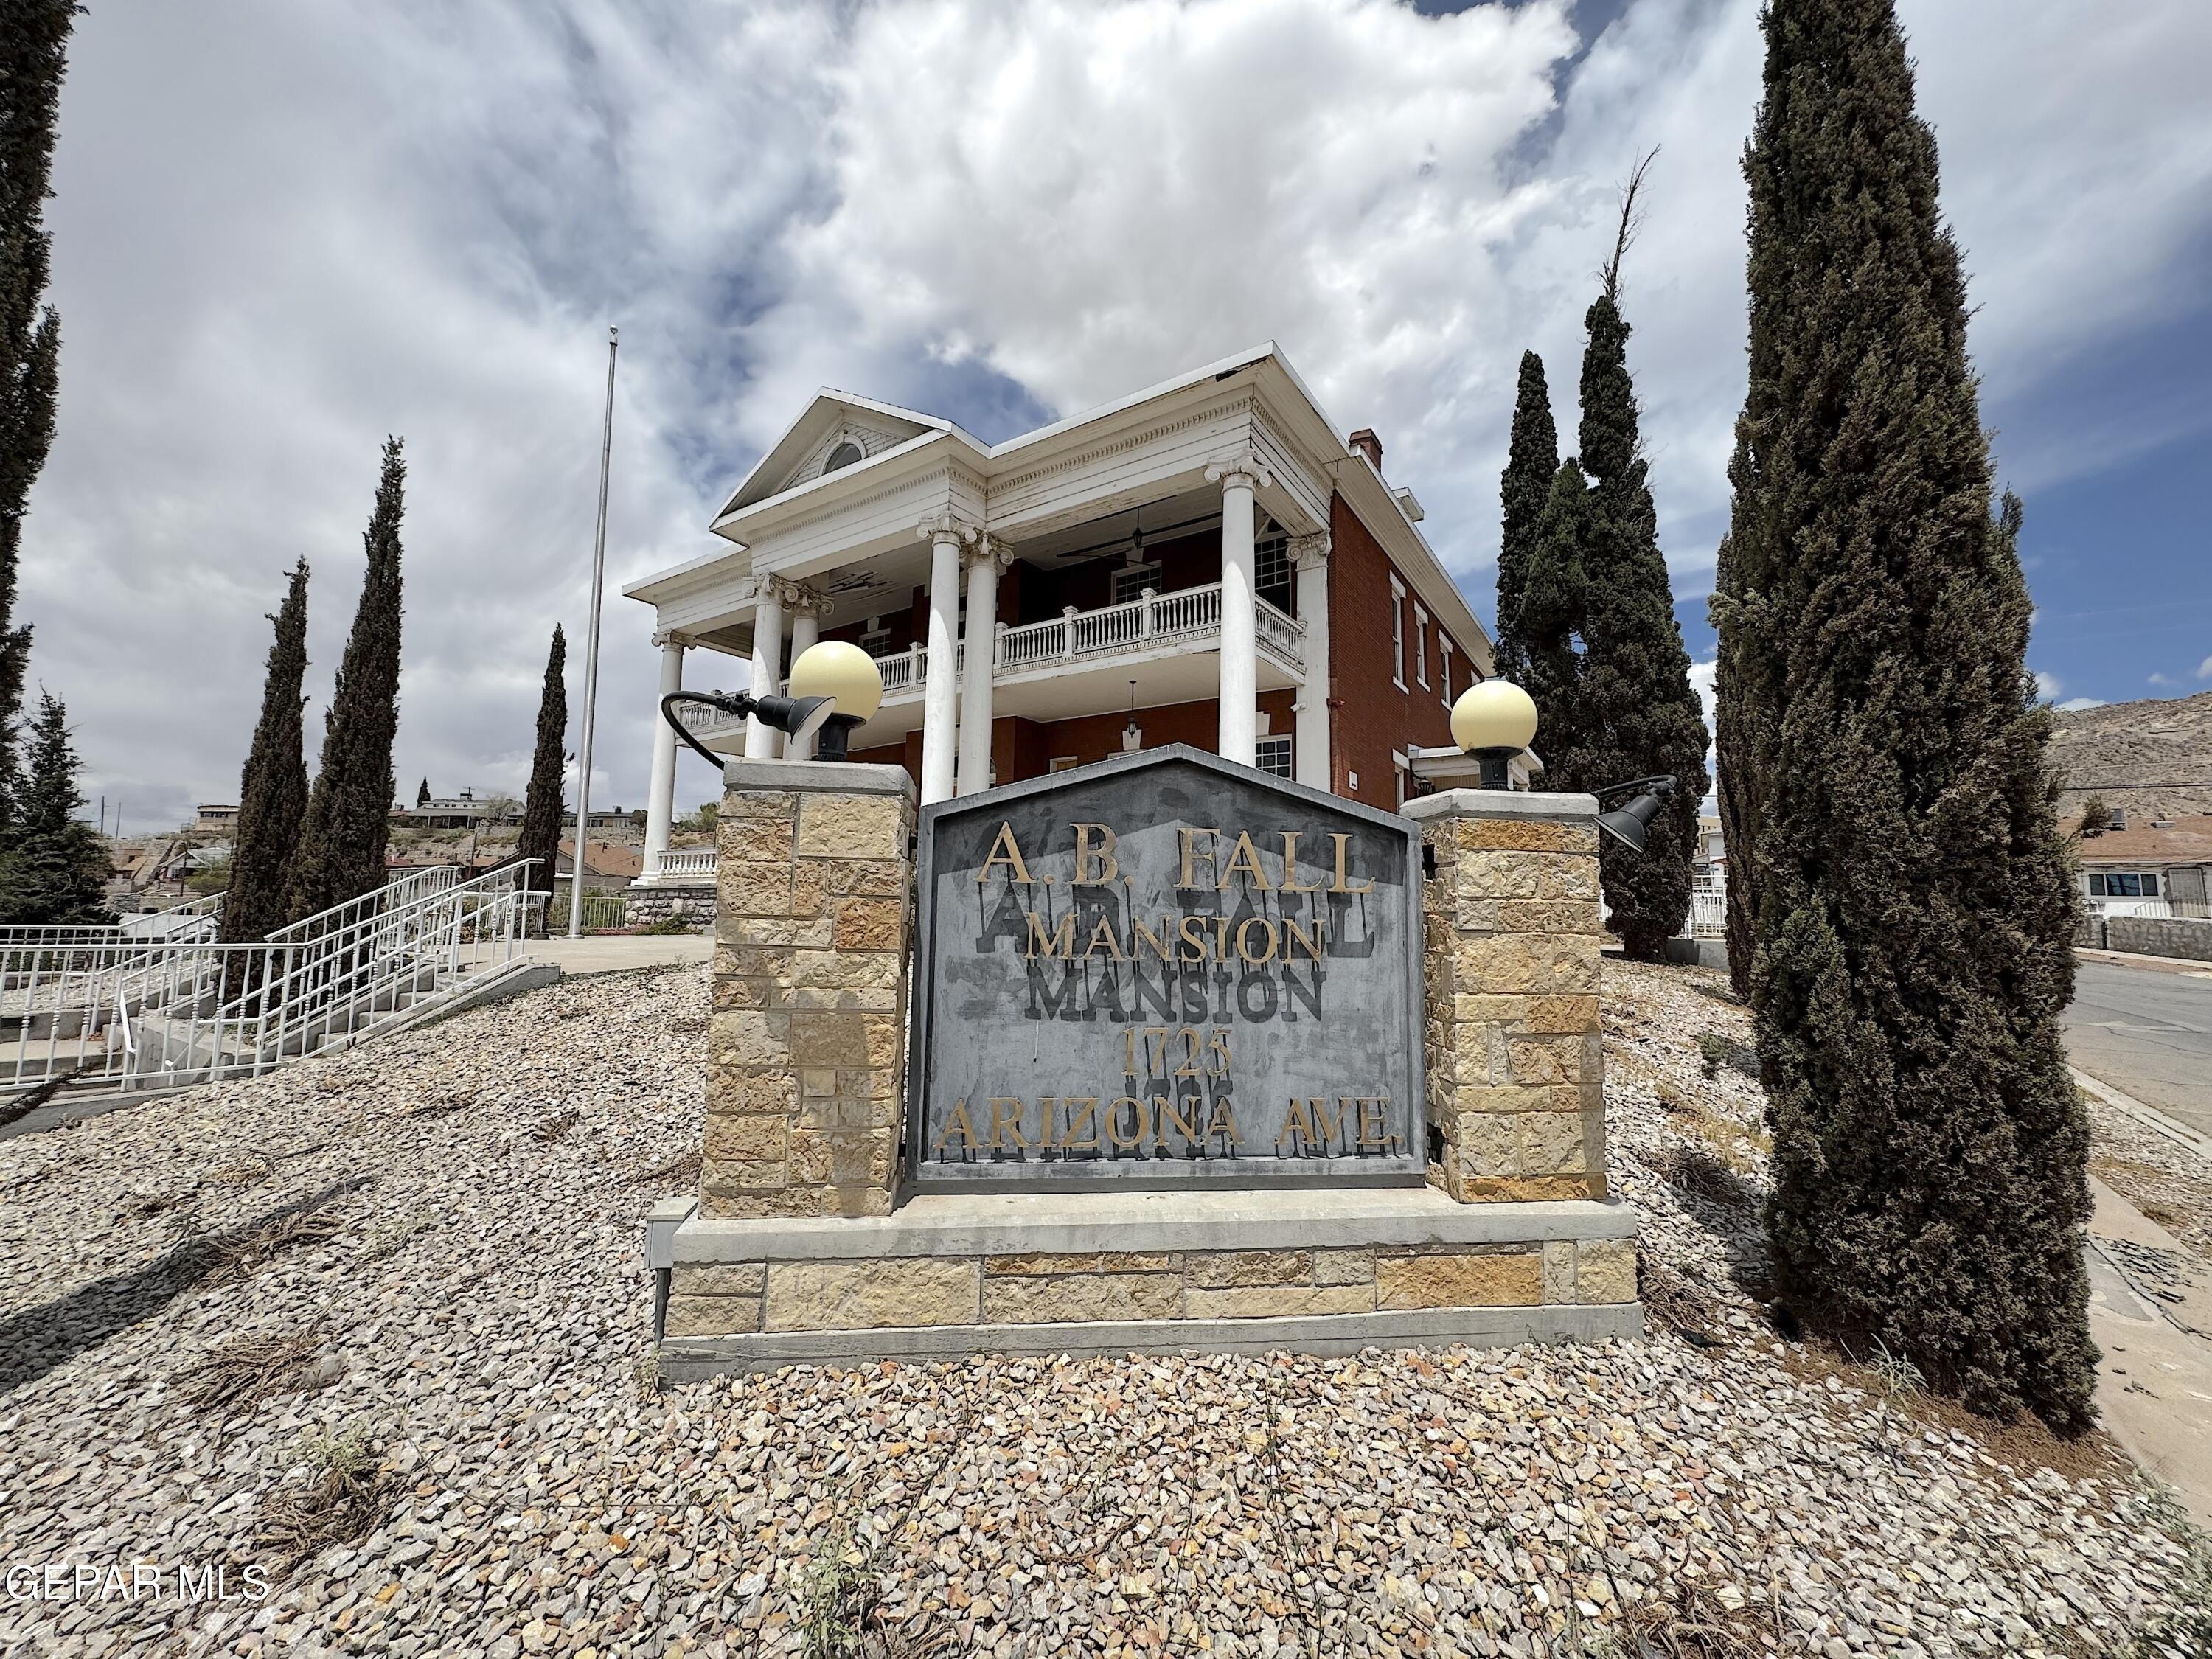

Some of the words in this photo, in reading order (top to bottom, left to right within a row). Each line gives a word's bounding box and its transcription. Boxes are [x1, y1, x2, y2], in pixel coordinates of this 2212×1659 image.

[1174, 827, 1375, 892] FALL
[1023, 911, 1326, 964] MANSION
[1121, 1026, 1232, 1077] 1725
[933, 1096, 1245, 1147] ARIZONA
[1274, 1096, 1404, 1145] AVE.
